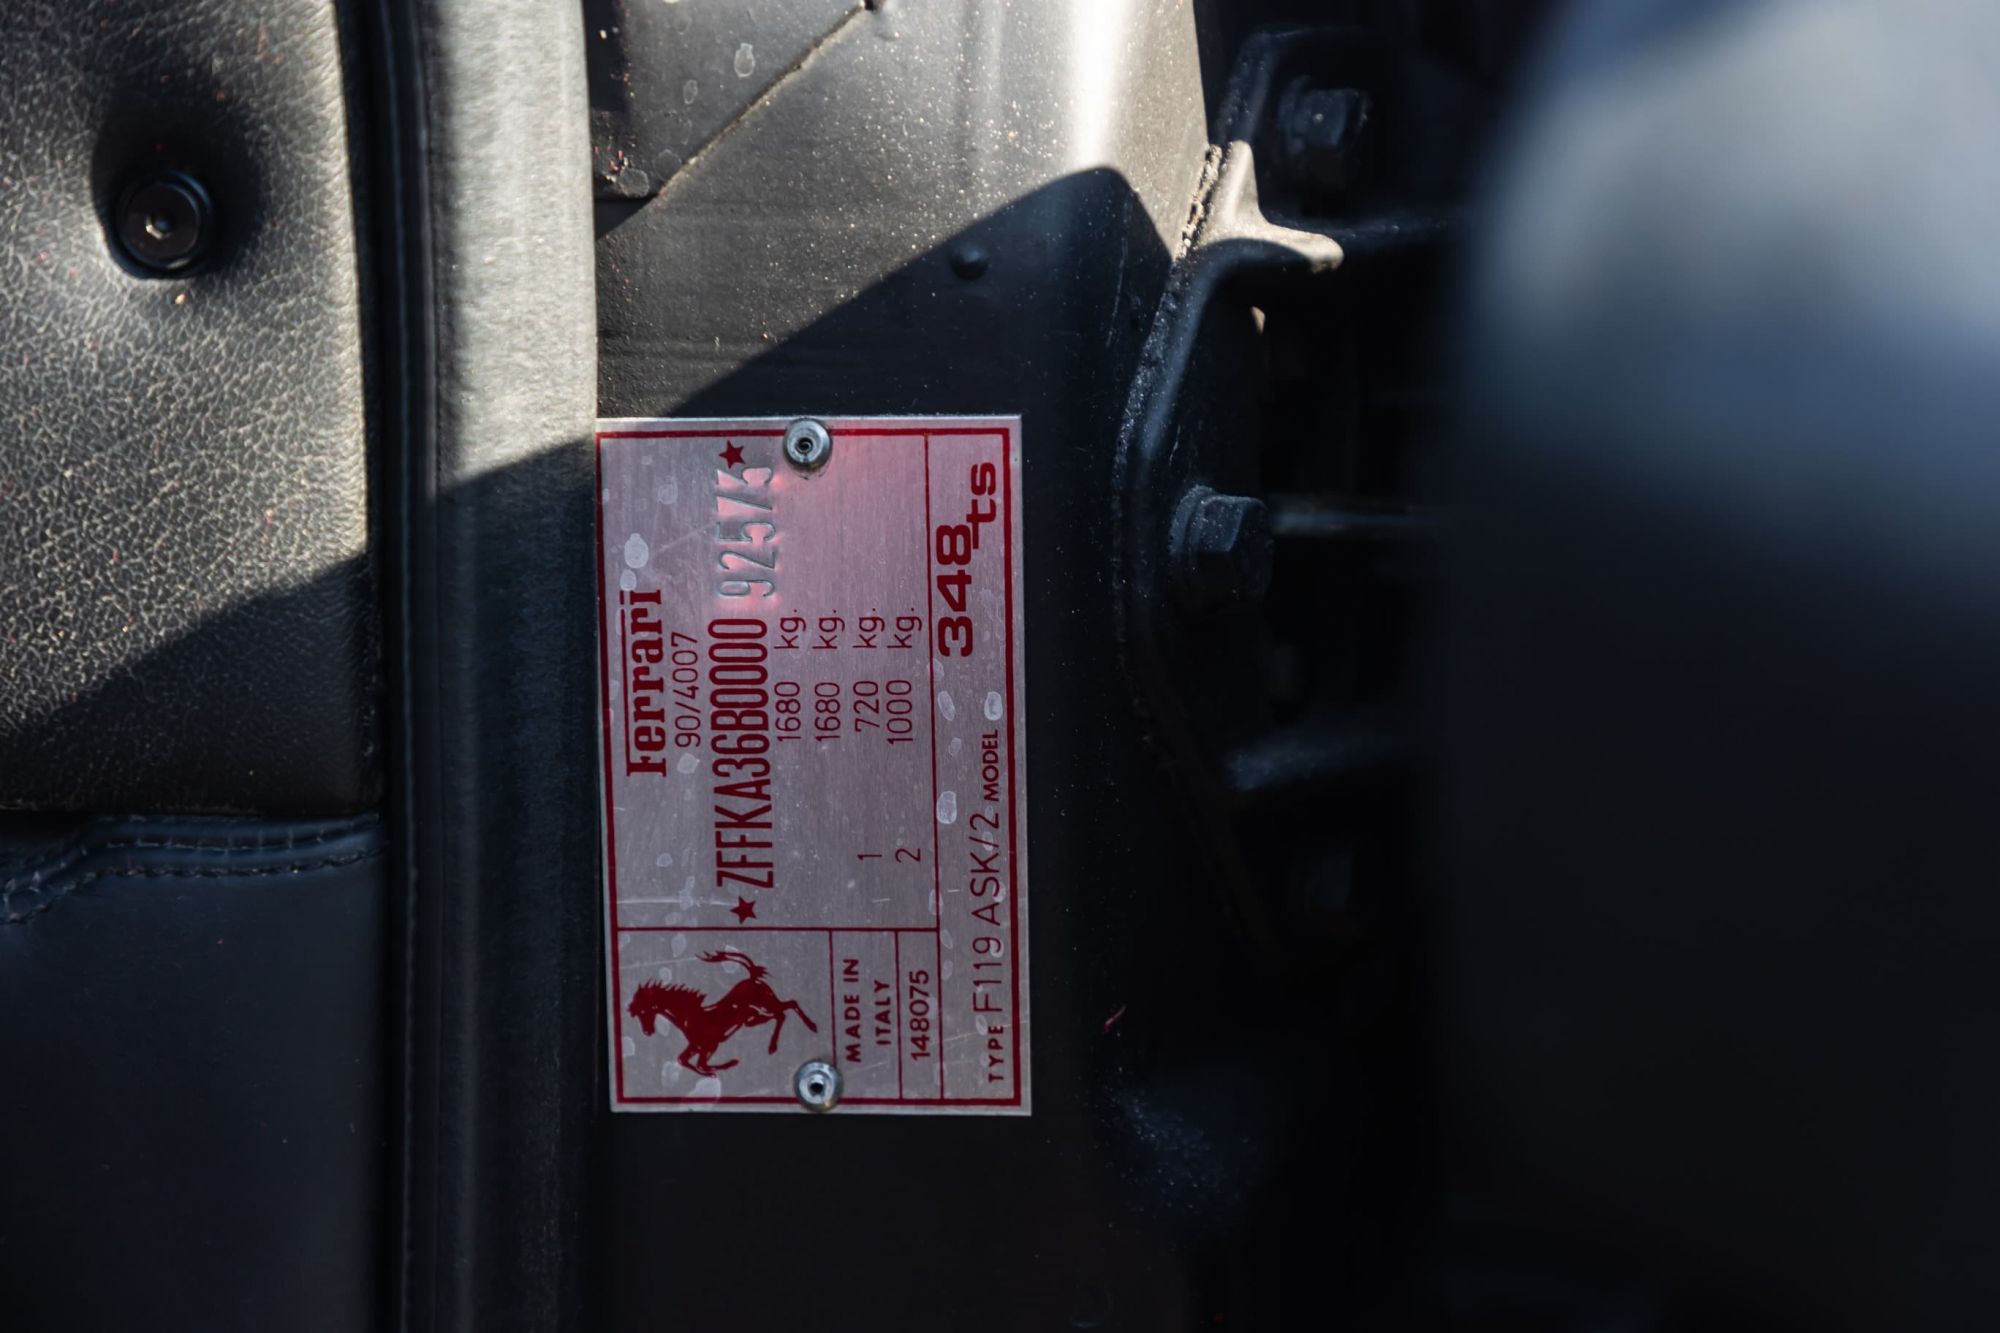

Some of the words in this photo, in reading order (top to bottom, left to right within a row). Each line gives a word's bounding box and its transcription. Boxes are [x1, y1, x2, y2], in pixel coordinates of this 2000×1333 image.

[712, 463, 777, 602] 92573
[775, 609, 805, 650] kg.
[813, 609, 845, 650] kg.
[852, 608, 885, 649] kg.
[888, 607, 922, 649] kg.
[620, 589, 667, 778] Ferrari
[671, 631, 702, 748] 90/4007
[774, 681, 802, 742] 1680
[814, 682, 841, 742] 1680
[852, 680, 881, 733] 720
[885, 679, 914, 745] 1000
[708, 618, 775, 889] ZFFKA36B0000
[981, 729, 1000, 802] MODEL
[857, 853, 883, 861] 1
[894, 847, 921, 863] 2
[842, 958, 859, 983] IN
[843, 994, 862, 1063] MADE
[873, 979, 891, 1046] ITALY
[908, 969, 931, 1061] 148075
[987, 1025, 1004, 1083] TYPE
